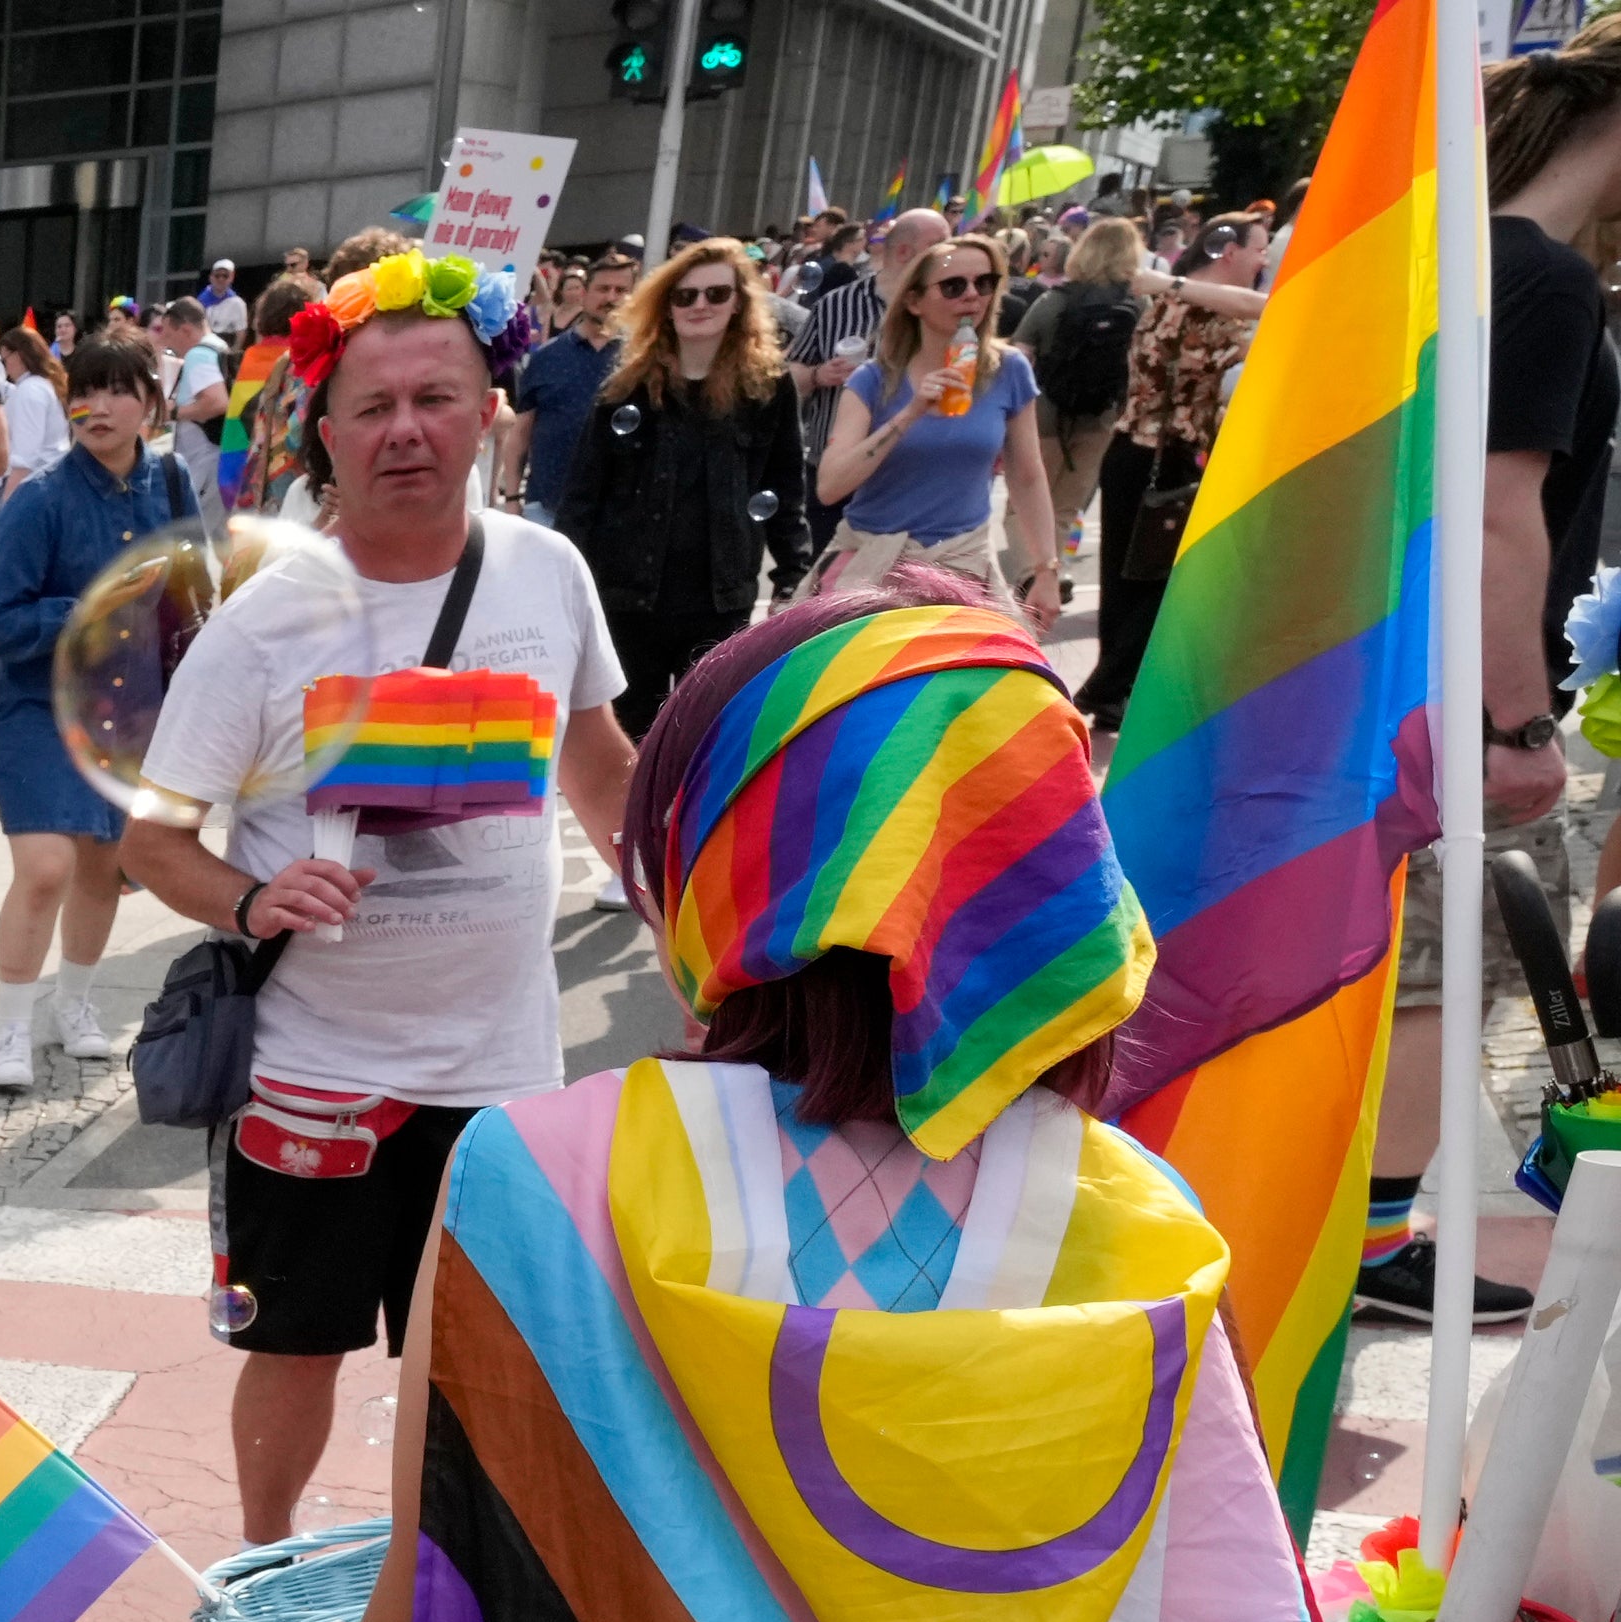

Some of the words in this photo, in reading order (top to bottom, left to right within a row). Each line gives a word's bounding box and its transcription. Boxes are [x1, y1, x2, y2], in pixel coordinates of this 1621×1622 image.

[444, 186, 474, 212] Mam
[433, 220, 455, 244] nie
[454, 221, 474, 246] od
[469, 225, 520, 254] parady!
[474, 626, 545, 649] ANNUAL
[476, 645, 549, 668] REGATTA
[368, 913, 392, 925] OF
[397, 912, 433, 925] THE
[1549, 990, 1570, 1029] Ziller
